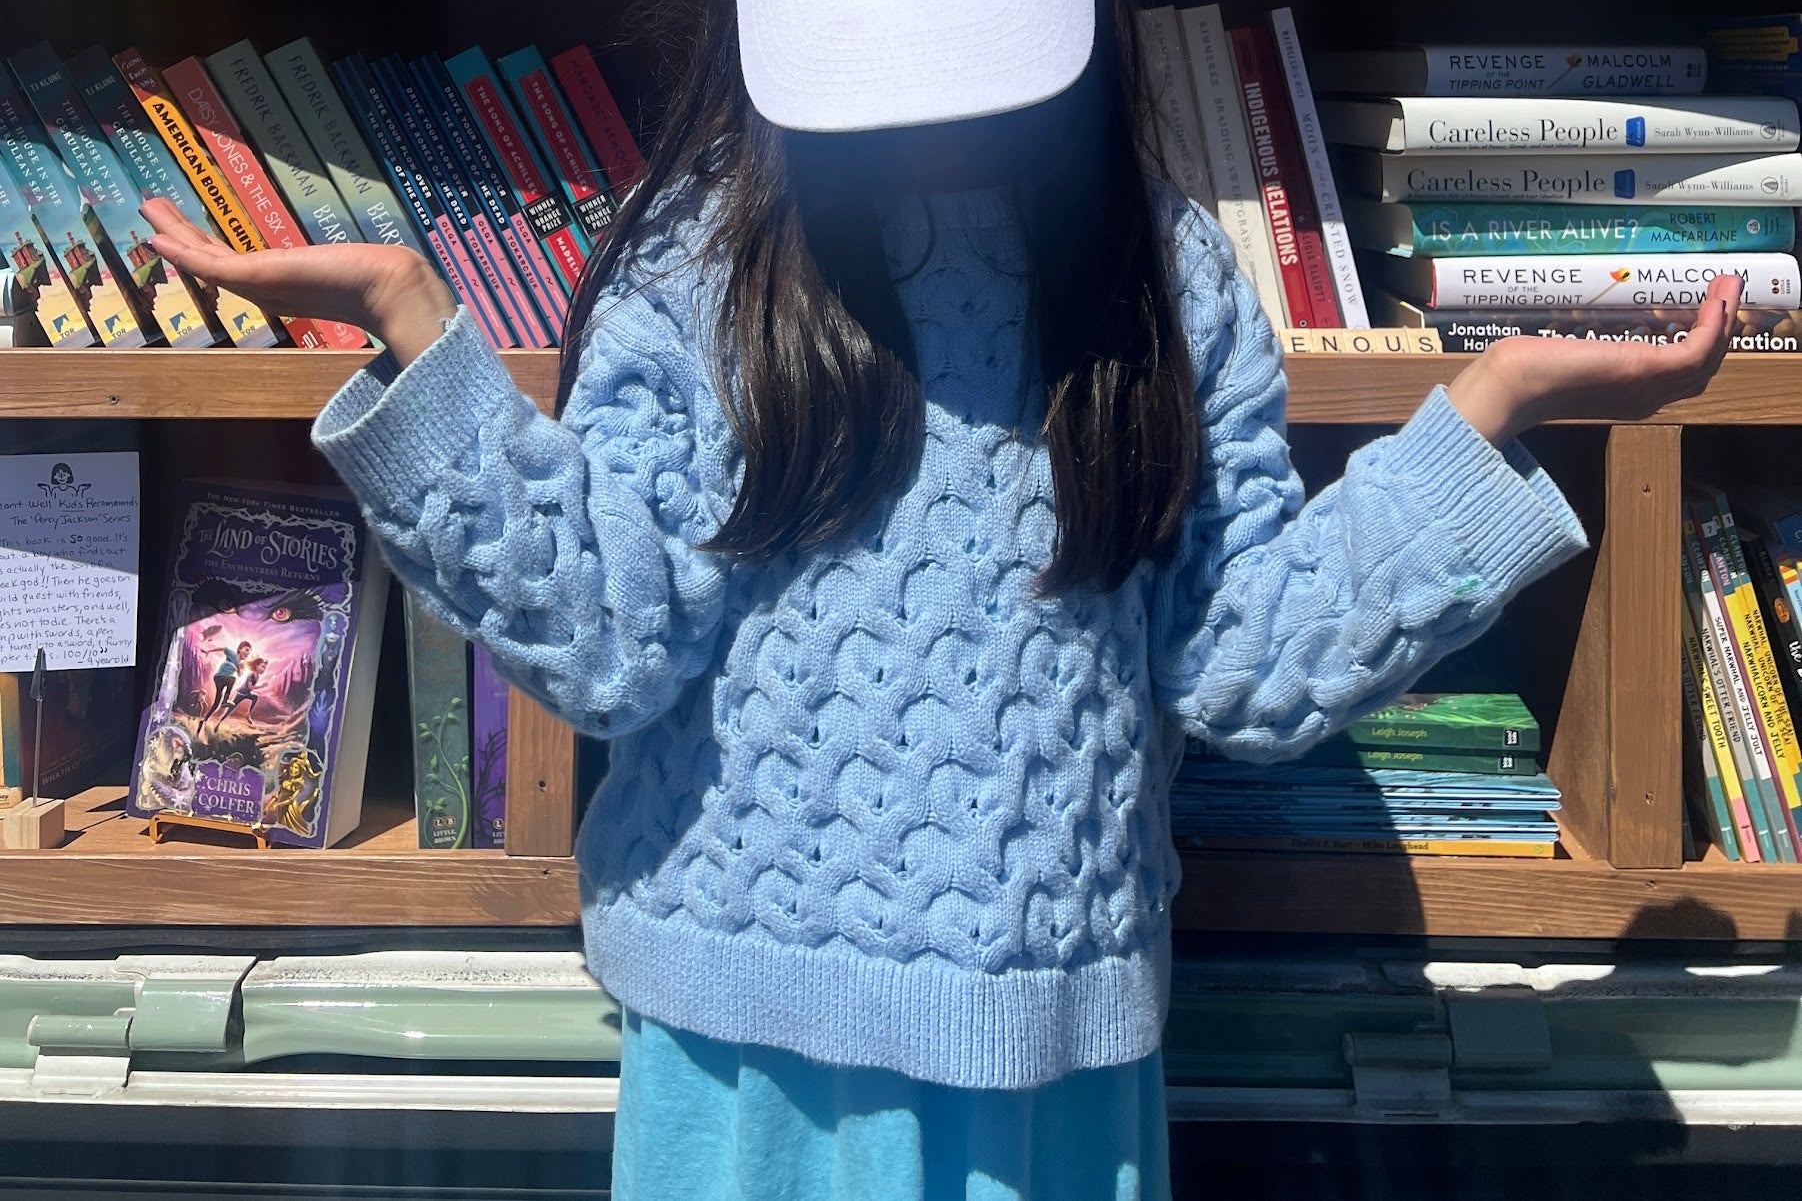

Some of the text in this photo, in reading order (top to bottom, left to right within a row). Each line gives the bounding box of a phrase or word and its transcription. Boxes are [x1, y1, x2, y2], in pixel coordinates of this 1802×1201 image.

[1449, 55, 1546, 70] REVENGE
[1587, 54, 1671, 68] MALCOLM
[1449, 79, 1546, 90] TIPPING POINT
[1583, 75, 1674, 88] GLADWELL
[1429, 120, 1617, 147] Careless People
[1655, 126, 1754, 137] Sarah Wynn-Williams
[55, 118, 106, 202] CERULEAN SEA
[153, 103, 232, 217] AMERICAN BORN
[1245, 82, 1298, 266] INDIGENOUS RELATIONS
[211, 130, 286, 235] JONES & THE SIX
[395, 165, 430, 227] OF THE DEAD
[529, 197, 556, 217] WINNER
[535, 208, 562, 227] ORANGE
[1669, 213, 1716, 226] ROBERT
[541, 218, 562, 233] PRIZE
[1432, 220, 1638, 241] IS A RIVER ALIVE?
[441, 222, 457, 246] OLGA
[1650, 227, 1737, 242] MACFARLANE
[431, 237, 463, 292] TOKARCZUK
[1337, 252, 1358, 305] SNOW
[1464, 269, 1583, 284] REVENGE
[1464, 294, 1583, 305] TIPPING POINT
[1633, 291, 1756, 304] GLADWL
[112, 328, 127, 339] TOR
[1448, 323, 1520, 336] Jonathan
[1292, 336, 1438, 354] ENOUS
[29, 500, 84, 509] Well Kids
[103, 515, 130, 523] Series
[86, 535, 113, 547] good.
[211, 519, 338, 571] LAND STORIES
[22, 589, 121, 605] quest with friends,
[63, 650, 98, 659] 100/10
[1715, 616, 1762, 756] SUPER NARWHAL AND JELLY JOLT
[1372, 727, 1427, 739] Leigh Joseph
[206, 777, 251, 796] CHRIS
[199, 793, 255, 815] COLFER
